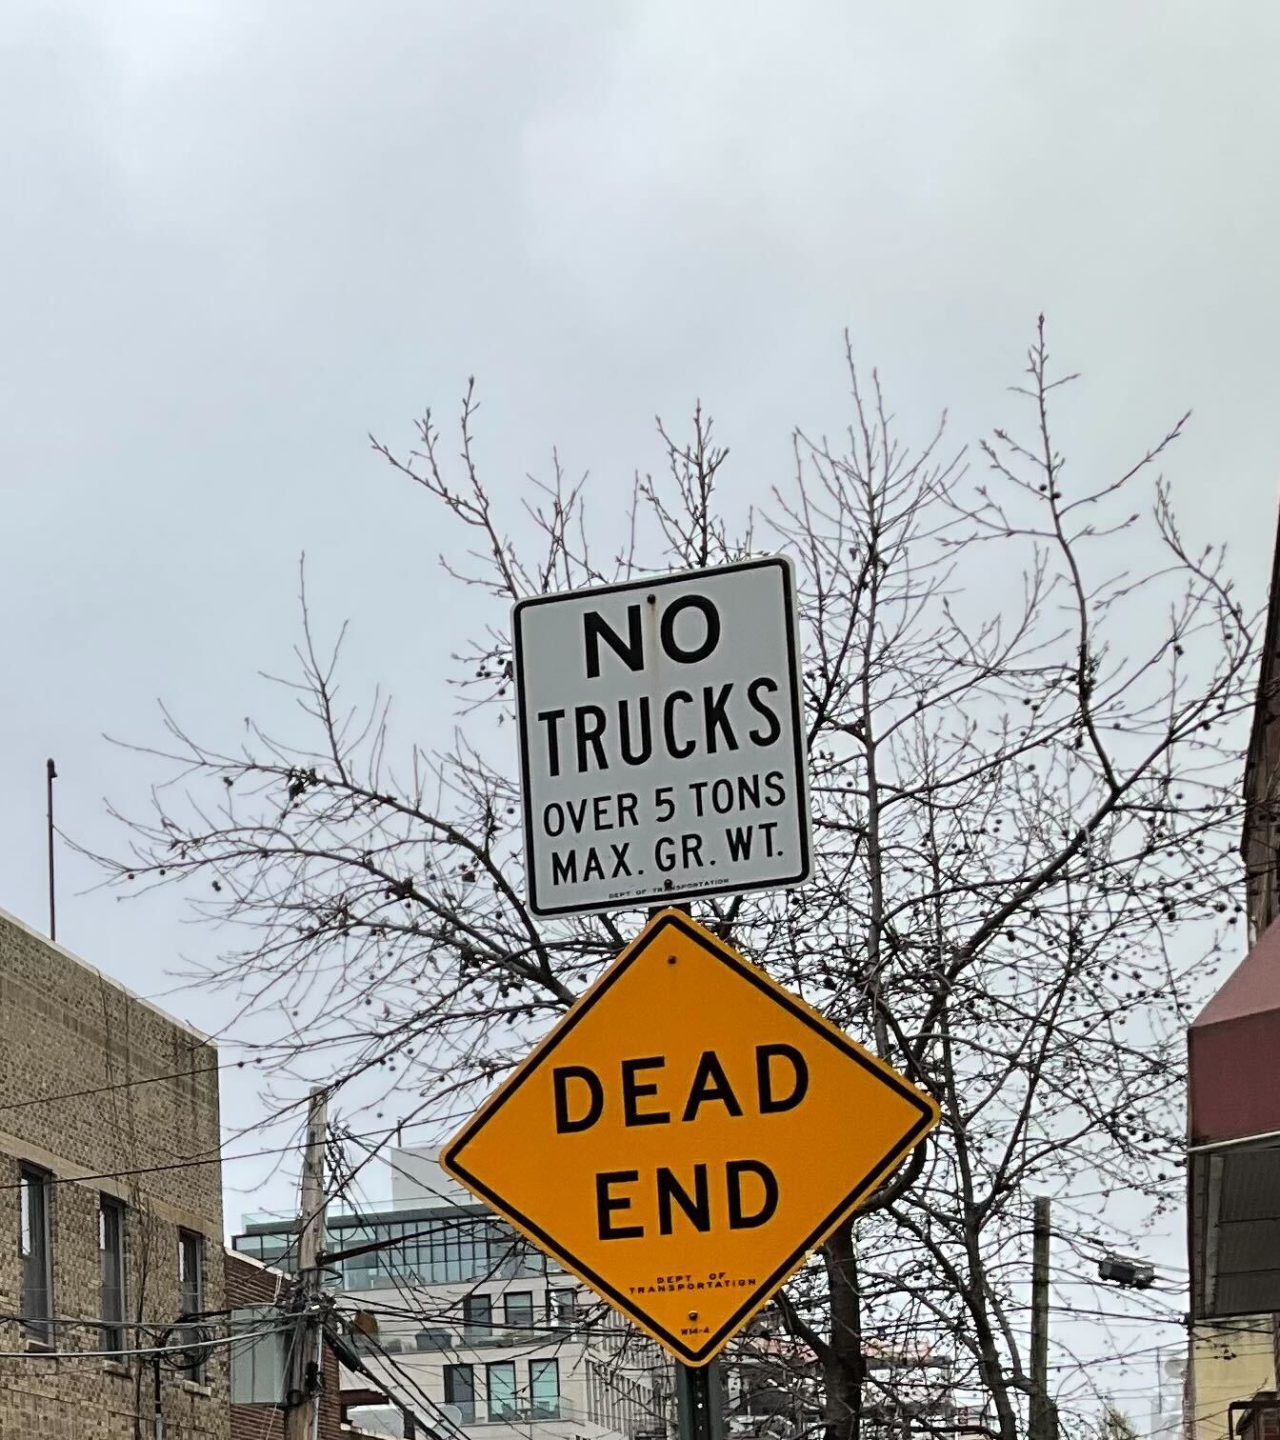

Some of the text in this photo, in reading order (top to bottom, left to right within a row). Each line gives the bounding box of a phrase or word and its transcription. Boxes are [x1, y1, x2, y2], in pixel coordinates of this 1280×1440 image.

[583, 594, 721, 679] NO
[537, 676, 782, 777] TRUCKS
[543, 770, 787, 838] OVER 5 TONS
[551, 821, 784, 886] MAX. GR. WT.
[608, 890, 632, 899] DEPT
[552, 1043, 810, 1135] DEAD
[595, 1159, 780, 1241] END
[629, 1279, 757, 1295] TRANSPORTATION
[657, 1272, 727, 1284] DEPT OF
